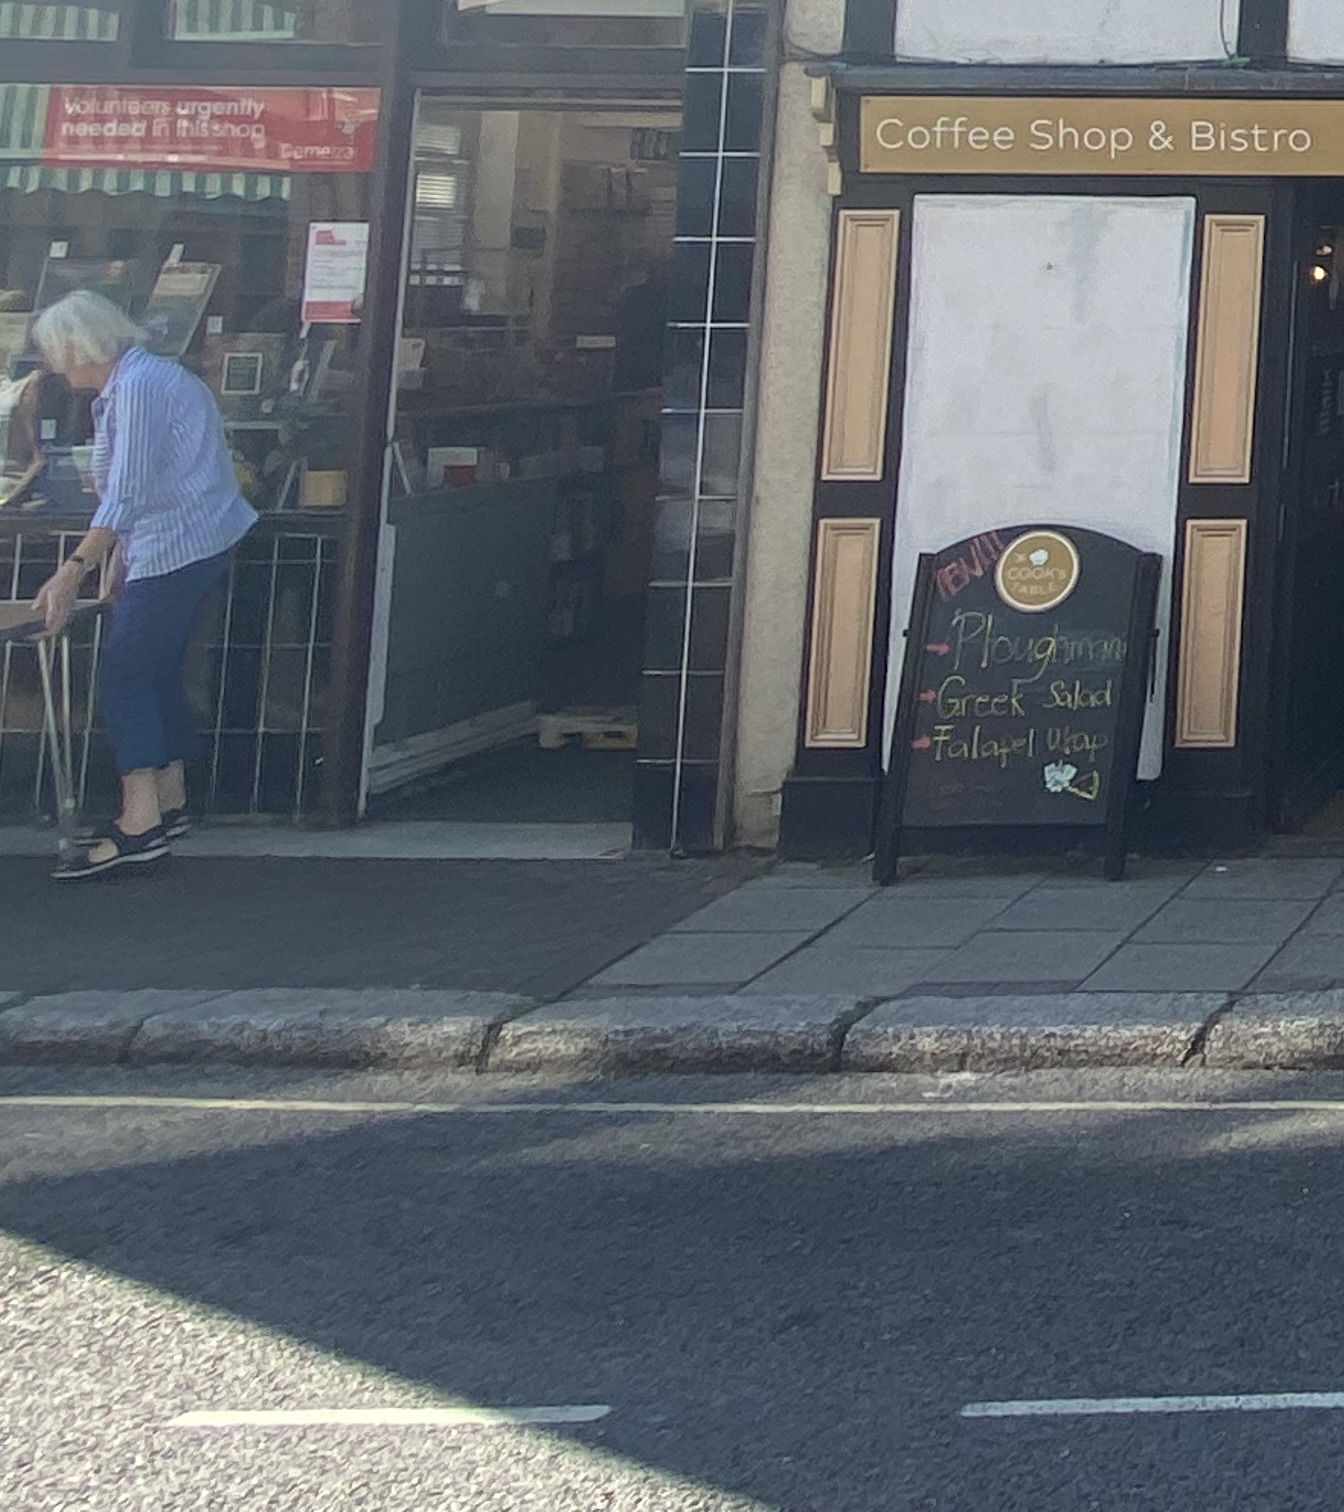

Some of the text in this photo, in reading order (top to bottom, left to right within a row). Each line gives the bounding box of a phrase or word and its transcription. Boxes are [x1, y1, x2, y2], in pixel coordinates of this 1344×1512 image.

[176, 97, 266, 120] urgently
[61, 119, 147, 138] needed
[152, 119, 170, 137] in
[175, 118, 209, 138] this
[875, 116, 1312, 159] Coffee Shop & Bistro
[937, 675, 1113, 720] Greek Salad
